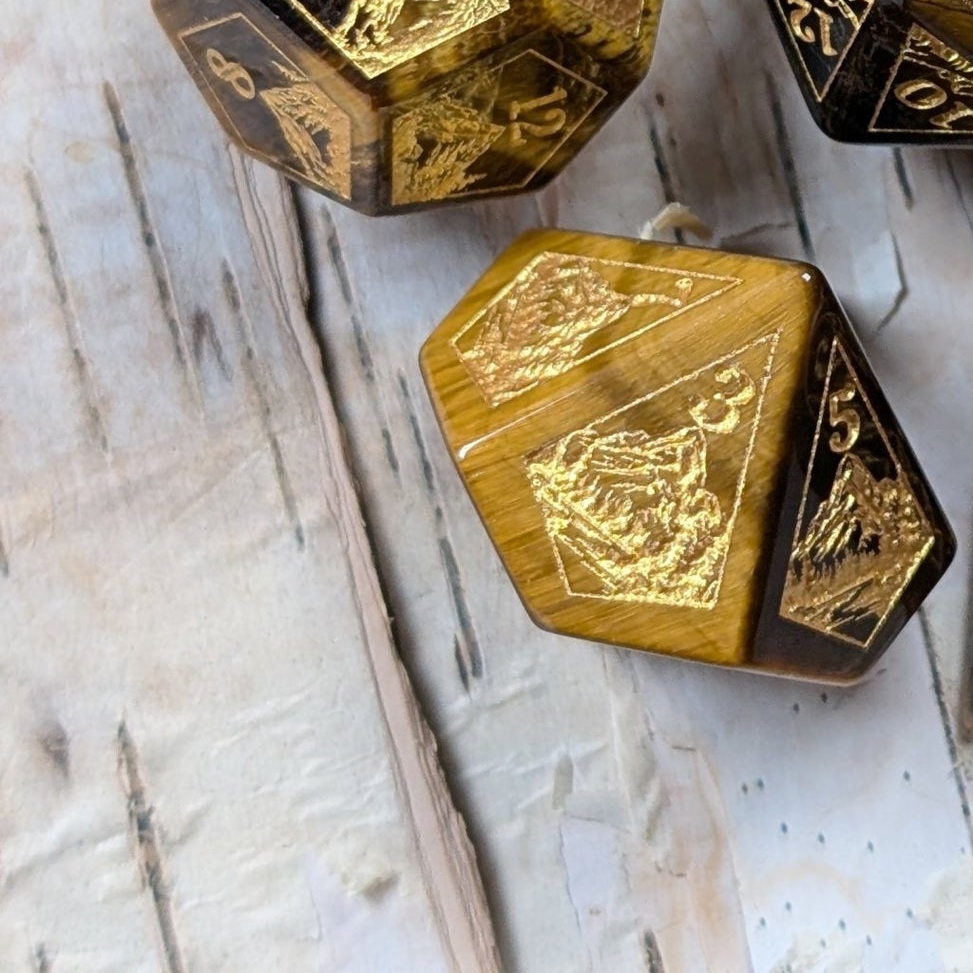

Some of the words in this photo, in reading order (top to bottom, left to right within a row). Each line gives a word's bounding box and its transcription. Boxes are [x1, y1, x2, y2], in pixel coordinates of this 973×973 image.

[205, 47, 256, 100] 8
[509, 86, 567, 146] 12
[688, 363, 756, 434] 3
[828, 388, 861, 453] 5
